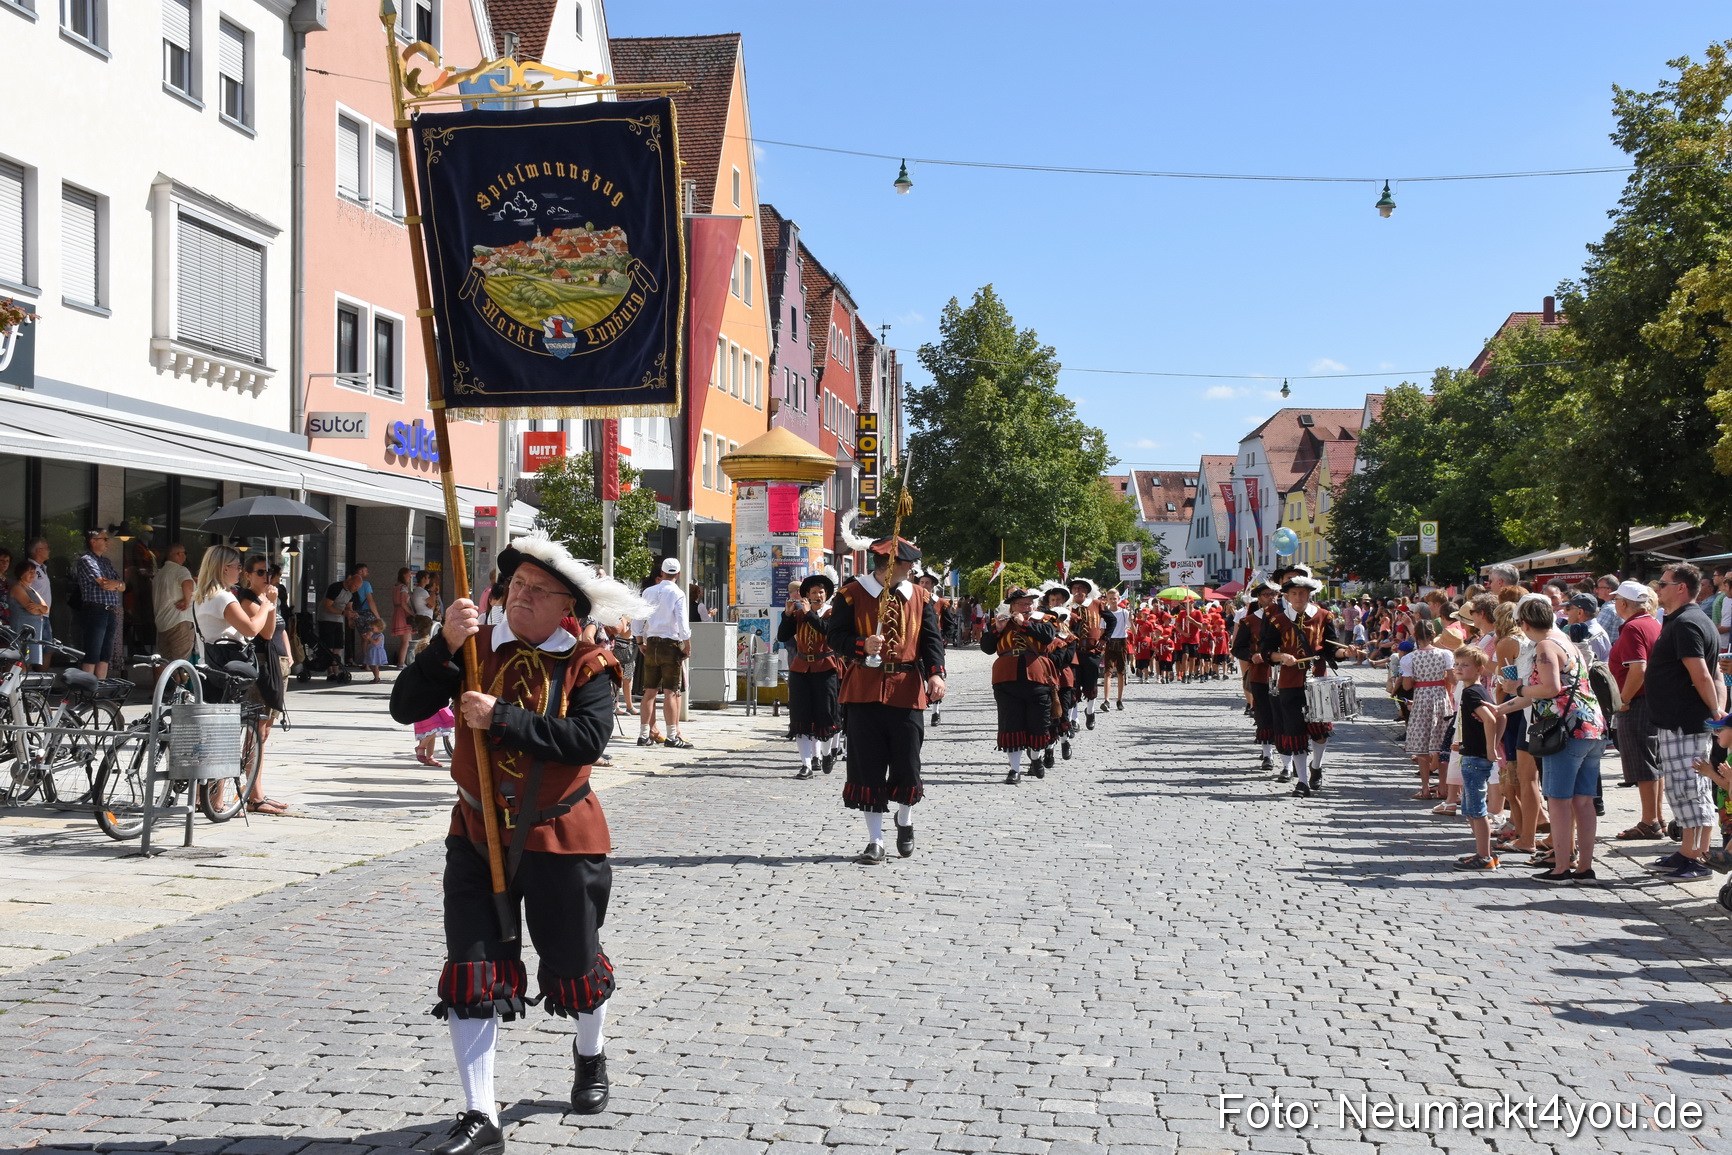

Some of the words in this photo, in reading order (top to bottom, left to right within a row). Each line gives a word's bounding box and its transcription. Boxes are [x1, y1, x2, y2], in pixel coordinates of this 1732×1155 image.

[477, 161, 624, 210] Spielmannszug
[482, 298, 535, 347] Markt
[585, 293, 645, 345] Lupburg
[310, 416, 364, 434] sutor.
[392, 419, 440, 463] suto
[529, 445, 558, 456] WITT
[860, 416, 876, 514] HOTEL
